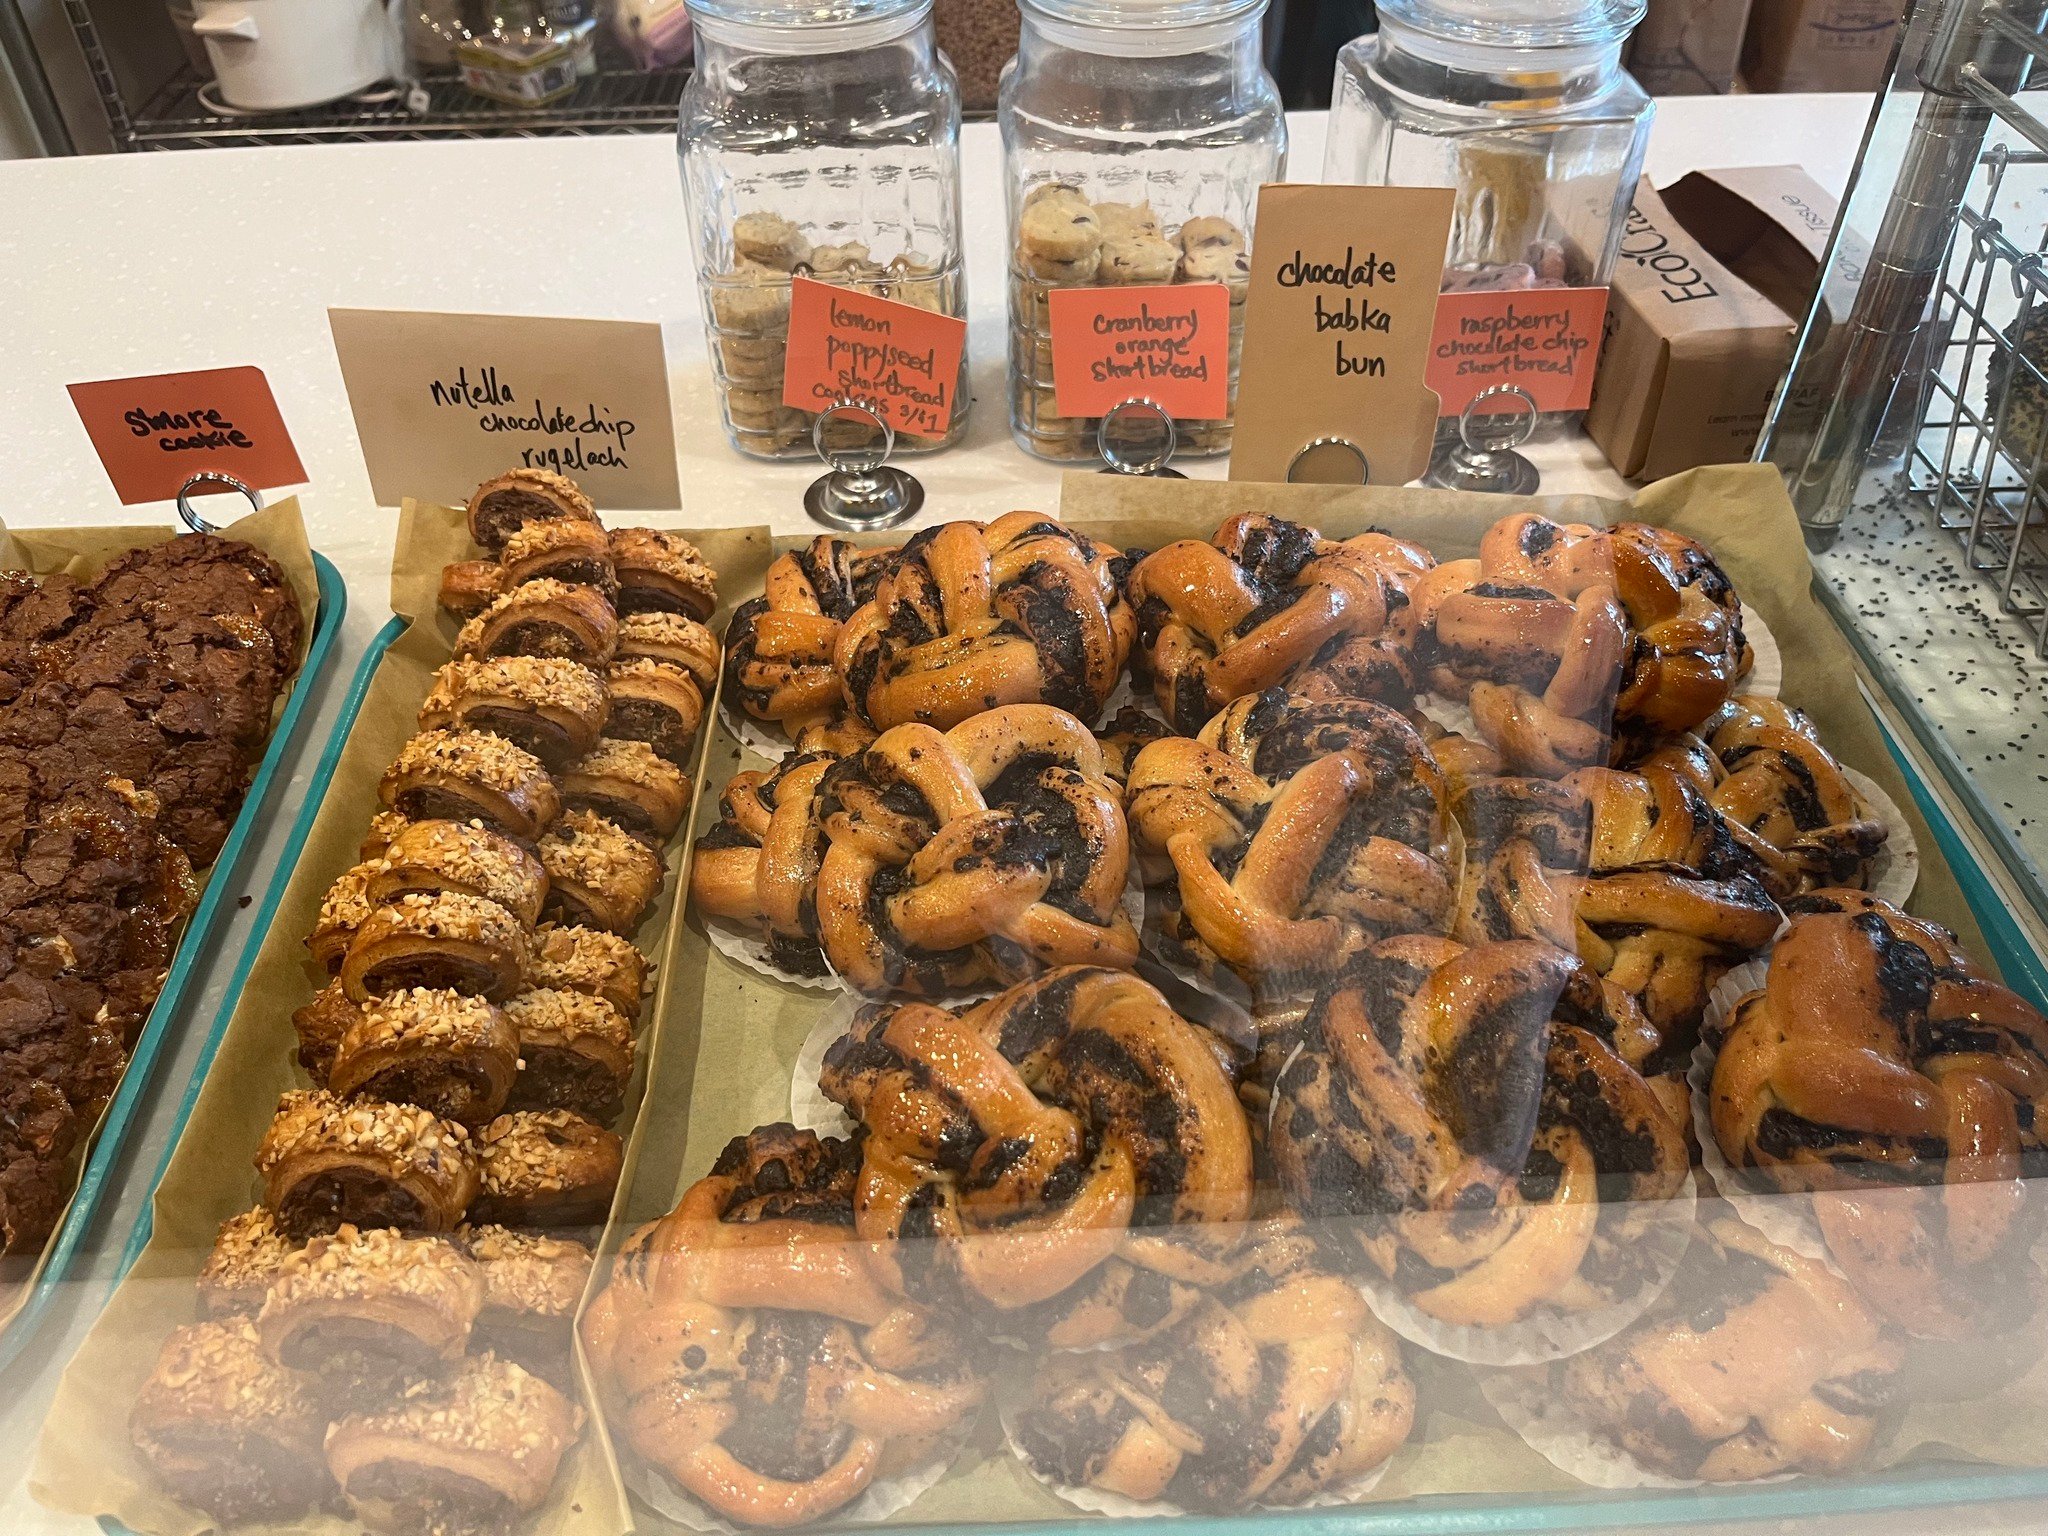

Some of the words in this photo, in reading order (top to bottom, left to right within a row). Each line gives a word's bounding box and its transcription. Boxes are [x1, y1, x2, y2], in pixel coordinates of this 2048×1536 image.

[1276, 246, 1396, 289] chocolate
[1619, 205, 1719, 303] EcoCra
[830, 297, 891, 335] lemon
[1314, 294, 1391, 333] babka
[1460, 304, 1570, 342] raspberry
[826, 334, 934, 380] poppyseed
[1115, 336, 1190, 365] orange
[1336, 340, 1385, 377] bun
[1436, 333, 1538, 358] chocolate
[1542, 331, 1589, 358] chip
[159, 430, 254, 451] cookie
[521, 436, 629, 476] rugelach
